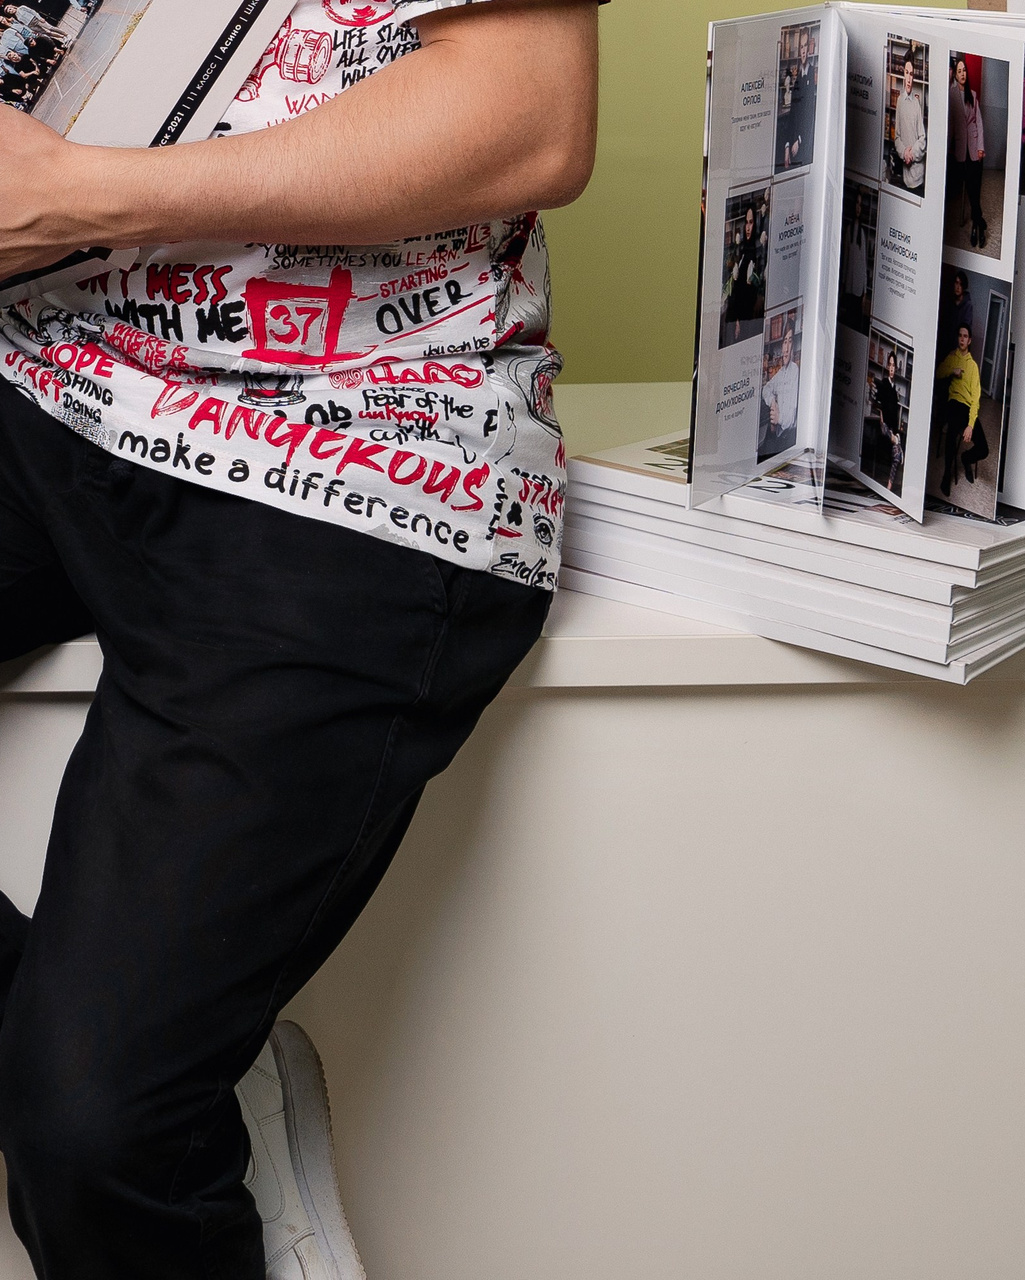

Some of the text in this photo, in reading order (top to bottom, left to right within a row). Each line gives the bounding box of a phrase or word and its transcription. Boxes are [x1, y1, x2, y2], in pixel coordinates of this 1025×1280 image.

[333, 26, 369, 51] LIFE
[336, 47, 370, 68] ALL
[167, 110, 185, 132] 2021
[187, 91, 198, 102] 11
[196, 62, 217, 90] класс
[219, 23, 242, 54] Асино
[740, 77, 765, 93] АЛЕКСЕЙ
[742, 94, 762, 107] ОРЛОВ
[880, 238, 918, 263] МАЛИНОВСКАЯ
[889, 227, 911, 245] ЕВГЕНИЯ
[272, 251, 368, 270] SOMETIMES
[370, 253, 403, 268] YOU
[145, 262, 233, 306] MESS
[379, 262, 449, 299] STARTING
[195, 301, 249, 344] ME
[376, 279, 474, 335] OVER
[268, 304, 325, 346] 37
[40, 342, 115, 379] NOPE
[62, 392, 102, 424] DOING
[362, 389, 474, 420] fear of the
[118, 430, 216, 474] make
[227, 458, 250, 482] a
[264, 461, 470, 553] difference
